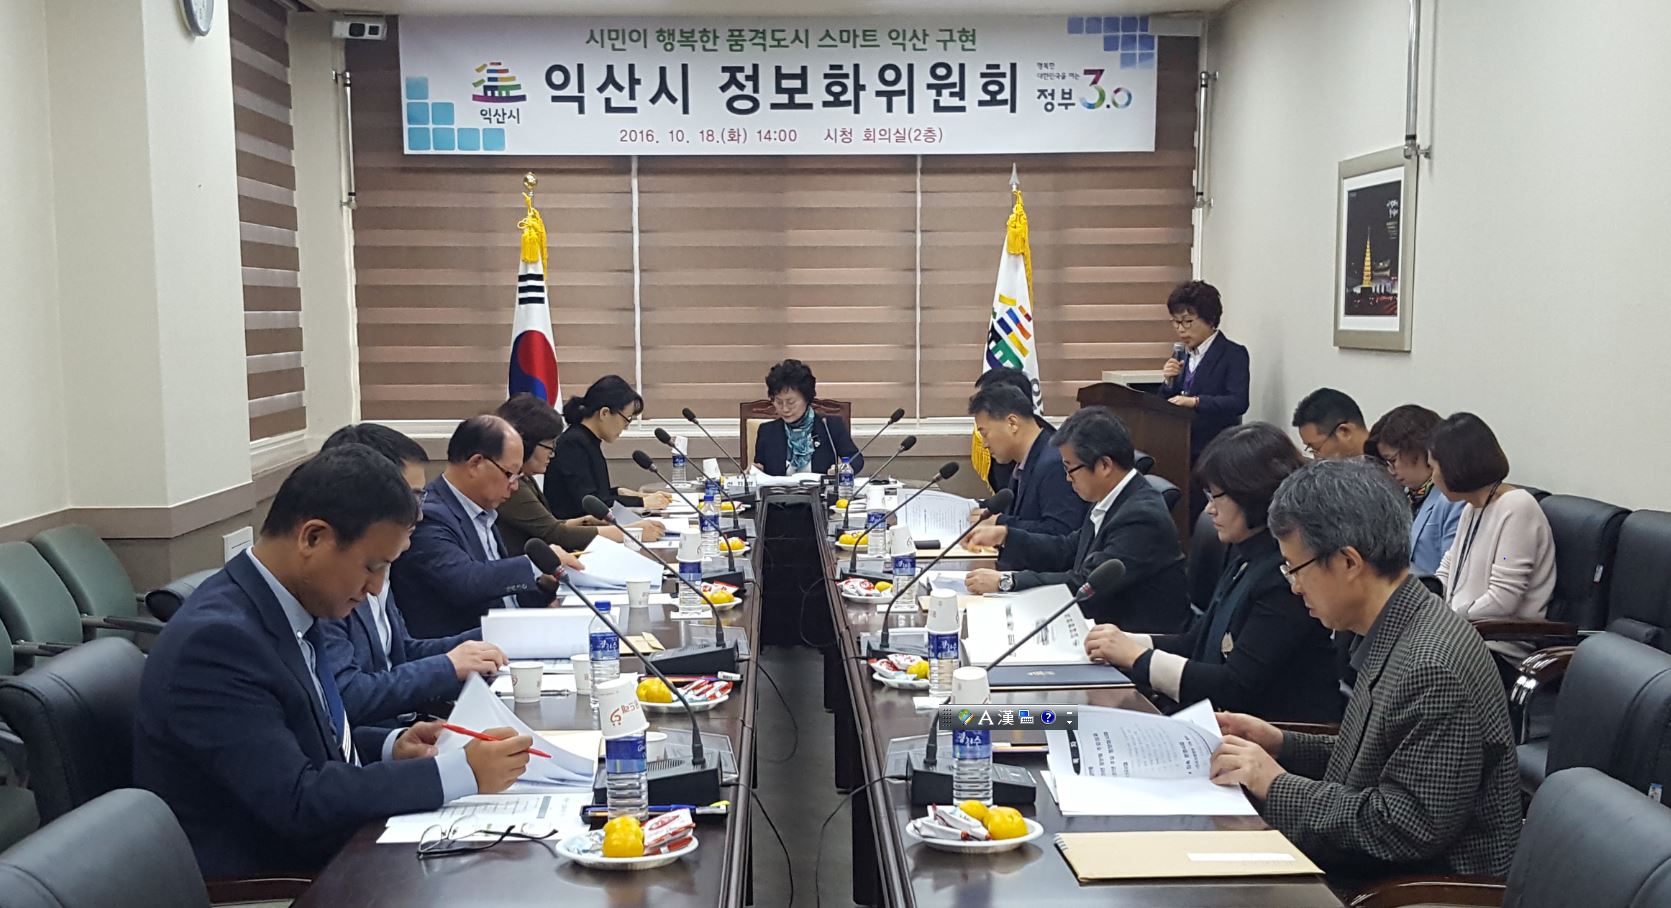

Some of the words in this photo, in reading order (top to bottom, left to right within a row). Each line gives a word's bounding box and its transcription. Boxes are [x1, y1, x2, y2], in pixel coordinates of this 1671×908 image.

[585, 28, 648, 52] 시민이
[655, 28, 720, 53] 행복한
[726, 28, 810, 53] 품격도시
[817, 28, 881, 49] 스마트
[887, 28, 930, 52] 익산
[936, 27, 977, 52] 구현
[544, 62, 690, 116] 익산시
[718, 61, 1018, 116] 정보화위원회
[1036, 88, 1076, 113] 정부
[479, 107, 521, 125] 익산시
[619, 129, 660, 144] 2016.
[668, 129, 690, 144] 10.
[699, 128, 748, 145] 18.(화)
[756, 128, 798, 143] 14:00
[824, 127, 853, 144] 시청
[862, 127, 943, 144] 회의실(2층)
